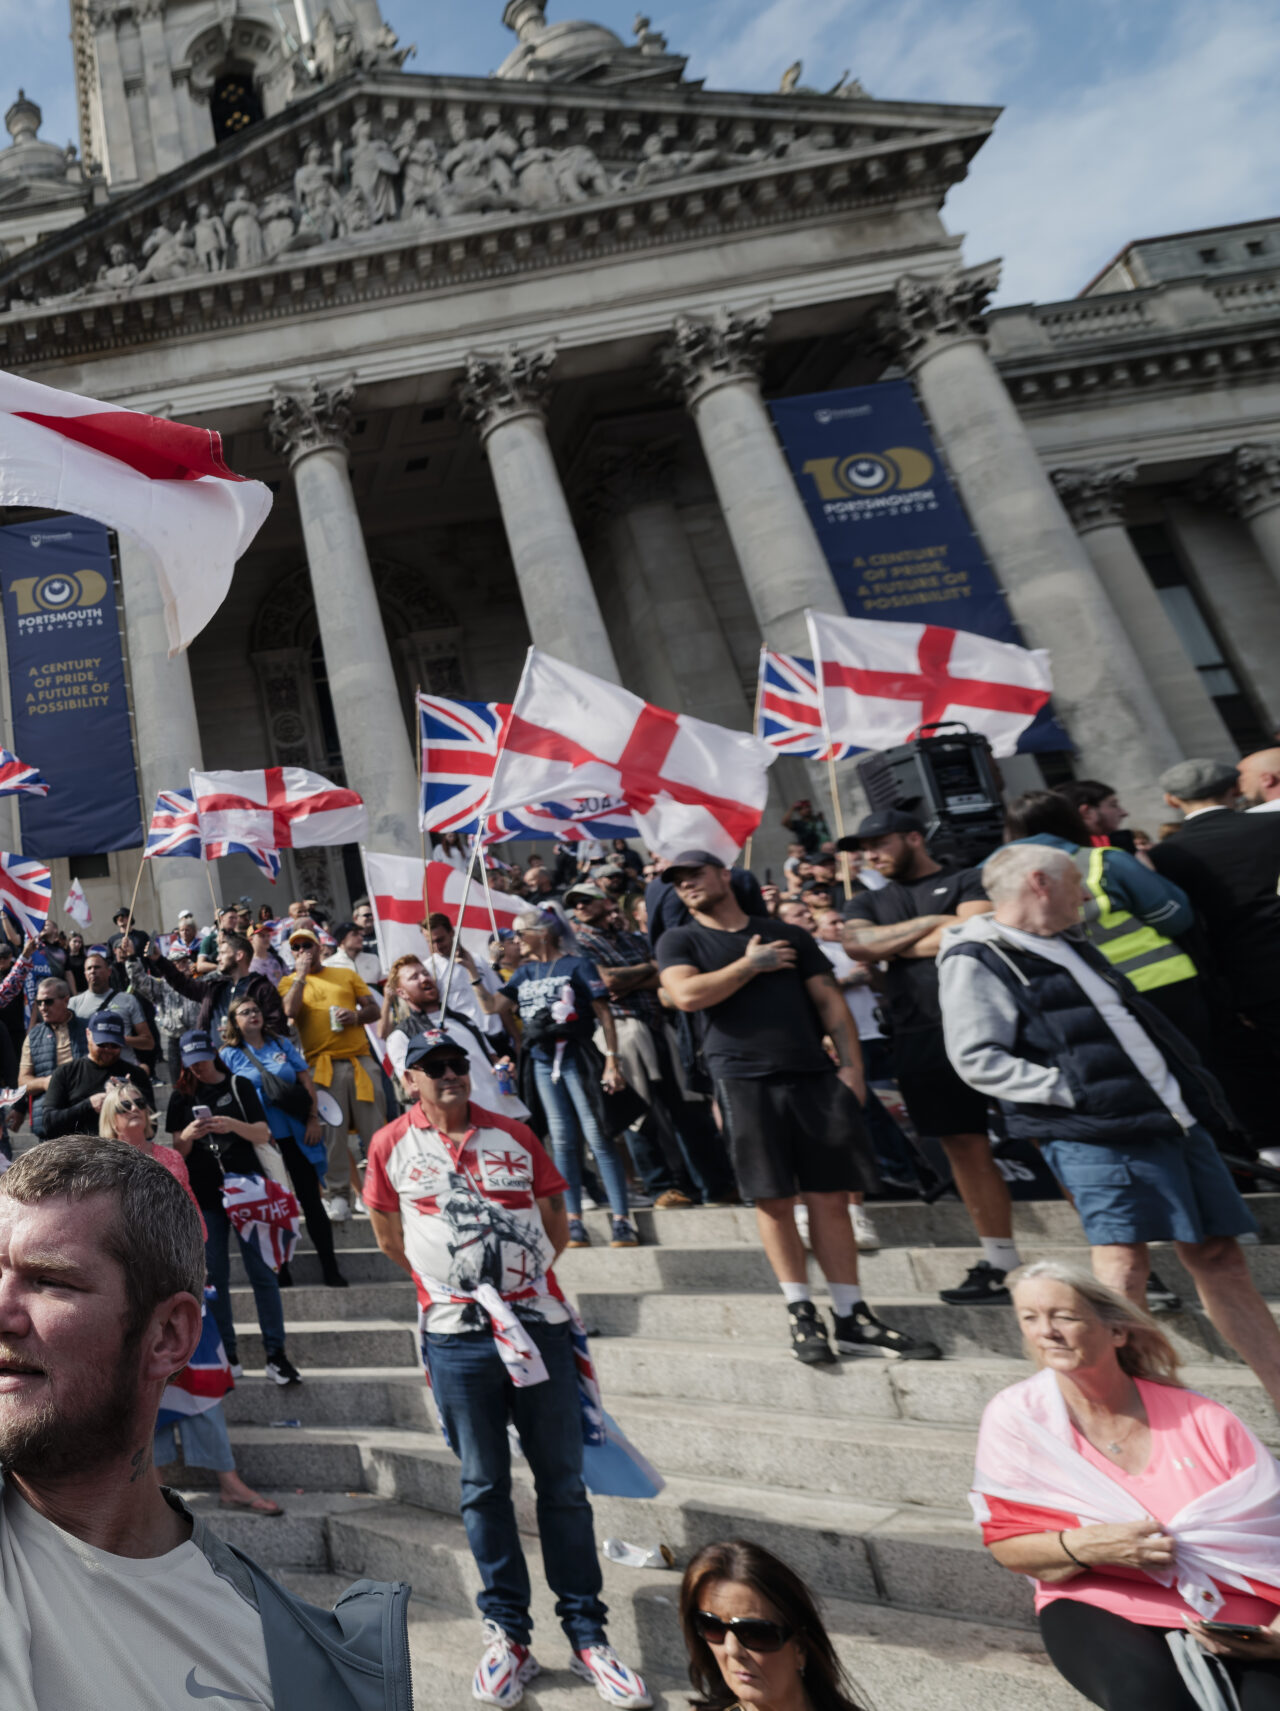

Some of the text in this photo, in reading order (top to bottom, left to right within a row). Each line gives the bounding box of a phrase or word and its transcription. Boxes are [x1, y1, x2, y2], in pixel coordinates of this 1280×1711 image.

[823, 489, 935, 514] PORTSMOUTH
[853, 544, 948, 568] A CENTURY
[857, 571, 968, 596] A FUTURE OF
[863, 568, 887, 581] OF
[863, 586, 971, 610] POSSIBILITY
[18, 608, 102, 627] PORTSMOUTH
[29, 658, 101, 677] A CENTURY
[34, 671, 98, 688] OF PRIDE,
[26, 683, 110, 703] A FUTURE OF
[28, 696, 109, 715] POSSIBILITY
[258, 1198, 290, 1219] THE
